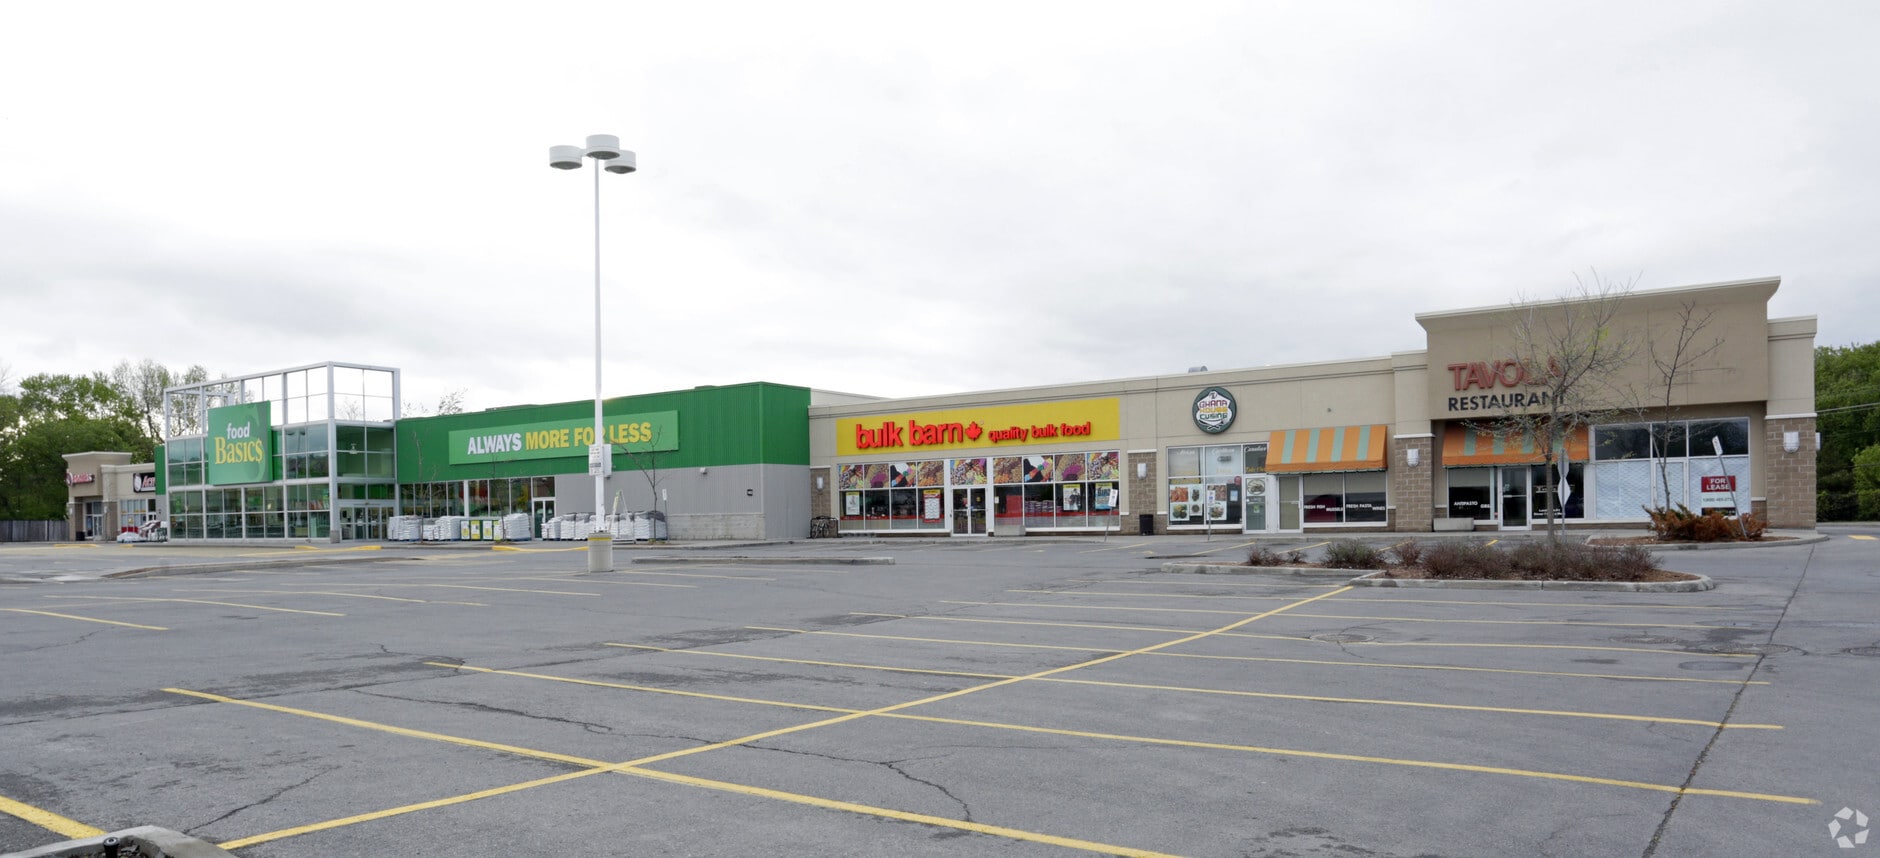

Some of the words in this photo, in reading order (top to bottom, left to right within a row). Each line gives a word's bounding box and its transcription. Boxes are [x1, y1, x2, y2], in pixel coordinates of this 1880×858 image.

[226, 421, 251, 440] food
[467, 433, 523, 455] ALWAYS
[525, 428, 570, 450] MORE
[609, 422, 653, 445] LESS
[855, 421, 904, 449] bulk
[908, 419, 964, 446] barn
[988, 426, 1029, 444] quality
[1031, 424, 1058, 438] bulk
[1060, 421, 1092, 436] food
